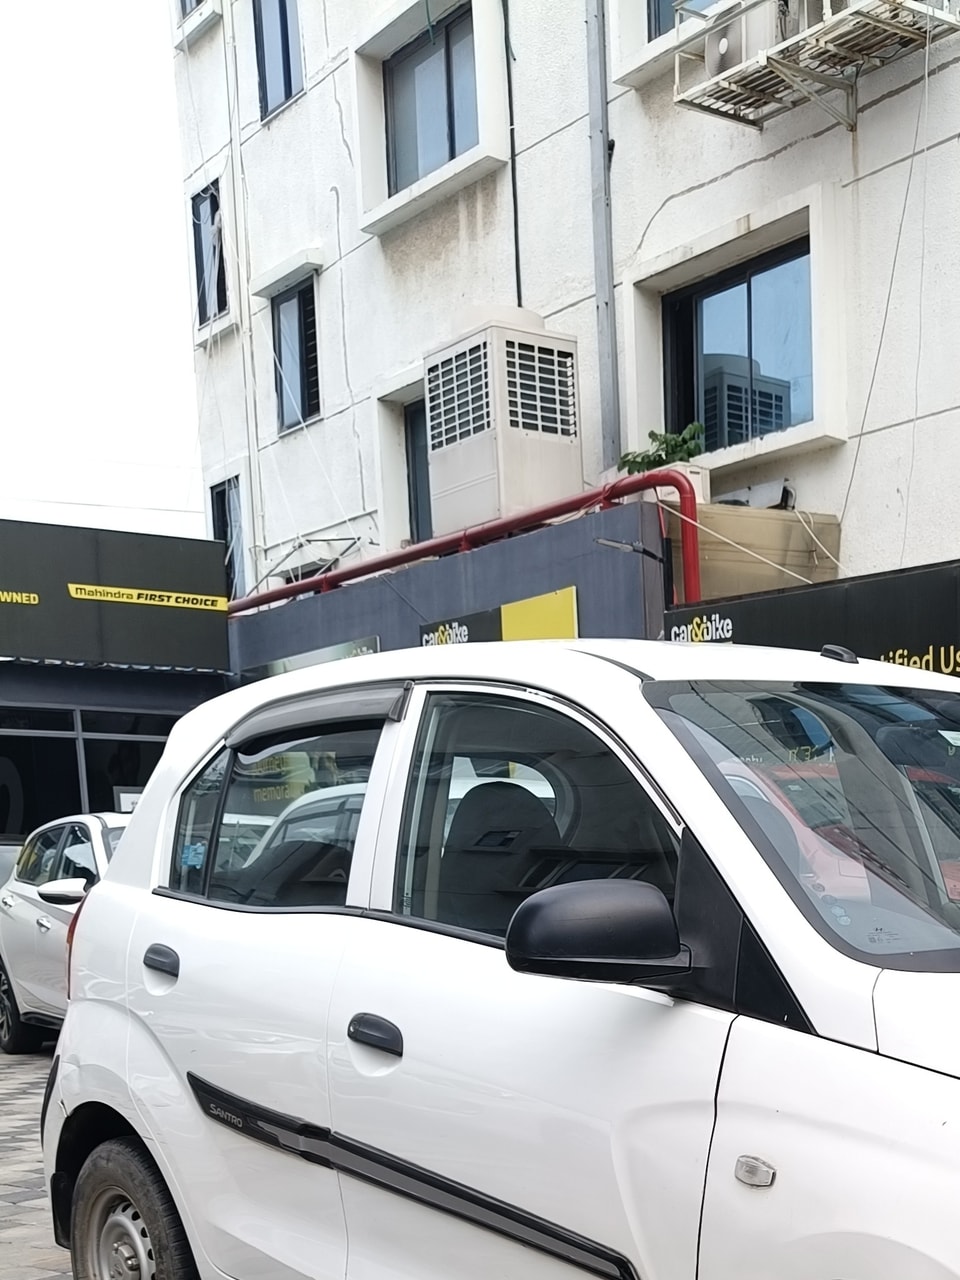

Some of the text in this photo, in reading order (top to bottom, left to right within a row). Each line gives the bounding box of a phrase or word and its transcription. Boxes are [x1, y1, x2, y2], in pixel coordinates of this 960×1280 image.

[75, 586, 219, 607] Mahindra FIRST CHOICE
[671, 613, 733, 642] car&bike
